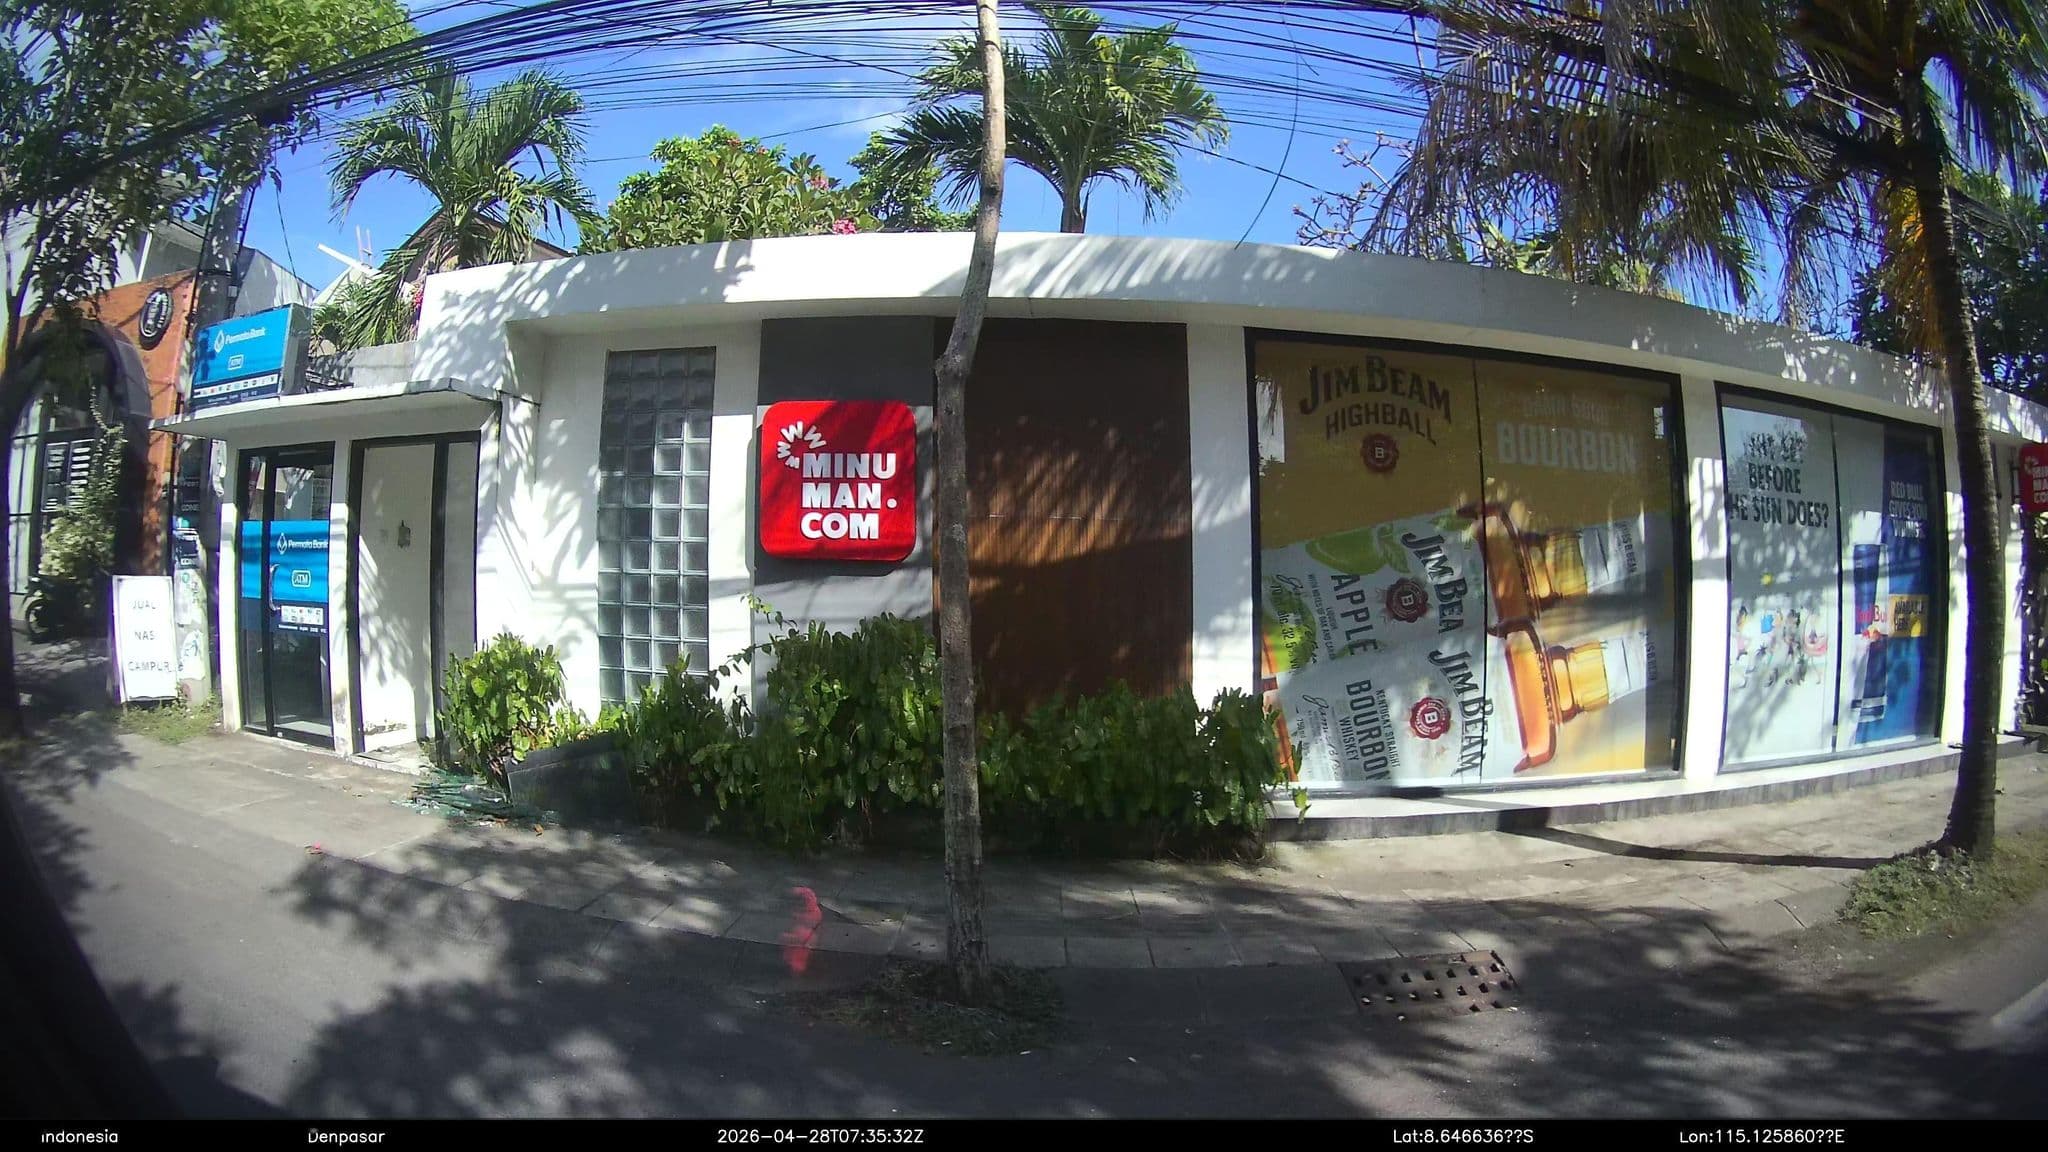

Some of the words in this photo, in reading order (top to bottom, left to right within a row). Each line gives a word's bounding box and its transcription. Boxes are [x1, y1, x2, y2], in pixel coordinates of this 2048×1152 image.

[1300, 365, 1360, 415] JIM
[1366, 354, 1451, 424] BEAM
[1326, 402, 1437, 446] HIGHBALL
[802, 453, 897, 480] MINU
[1497, 420, 1638, 475] BOURBON
[801, 483, 897, 509] MAN.
[1748, 462, 1801, 493] BEFORE
[800, 512, 880, 539] COM
[1753, 495, 1782, 524] SUN
[1787, 499, 1829, 528] DOES?
[294, 573, 309, 584] ATM
[1402, 532, 1454, 581] JIM
[1433, 577, 1468, 634] BEA
[1331, 574, 1379, 656] APPLE
[1401, 594, 1415, 607] B
[1427, 649, 1480, 697] JIM
[1376, 689, 1393, 729] KENTUCKY
[1424, 711, 1439, 725] B
[1340, 716, 1360, 760] WHISKEY
[1346, 680, 1392, 779] BOURBON
[1384, 731, 1400, 768] STRAIGHT
[1451, 696, 1494, 777] BEAM
